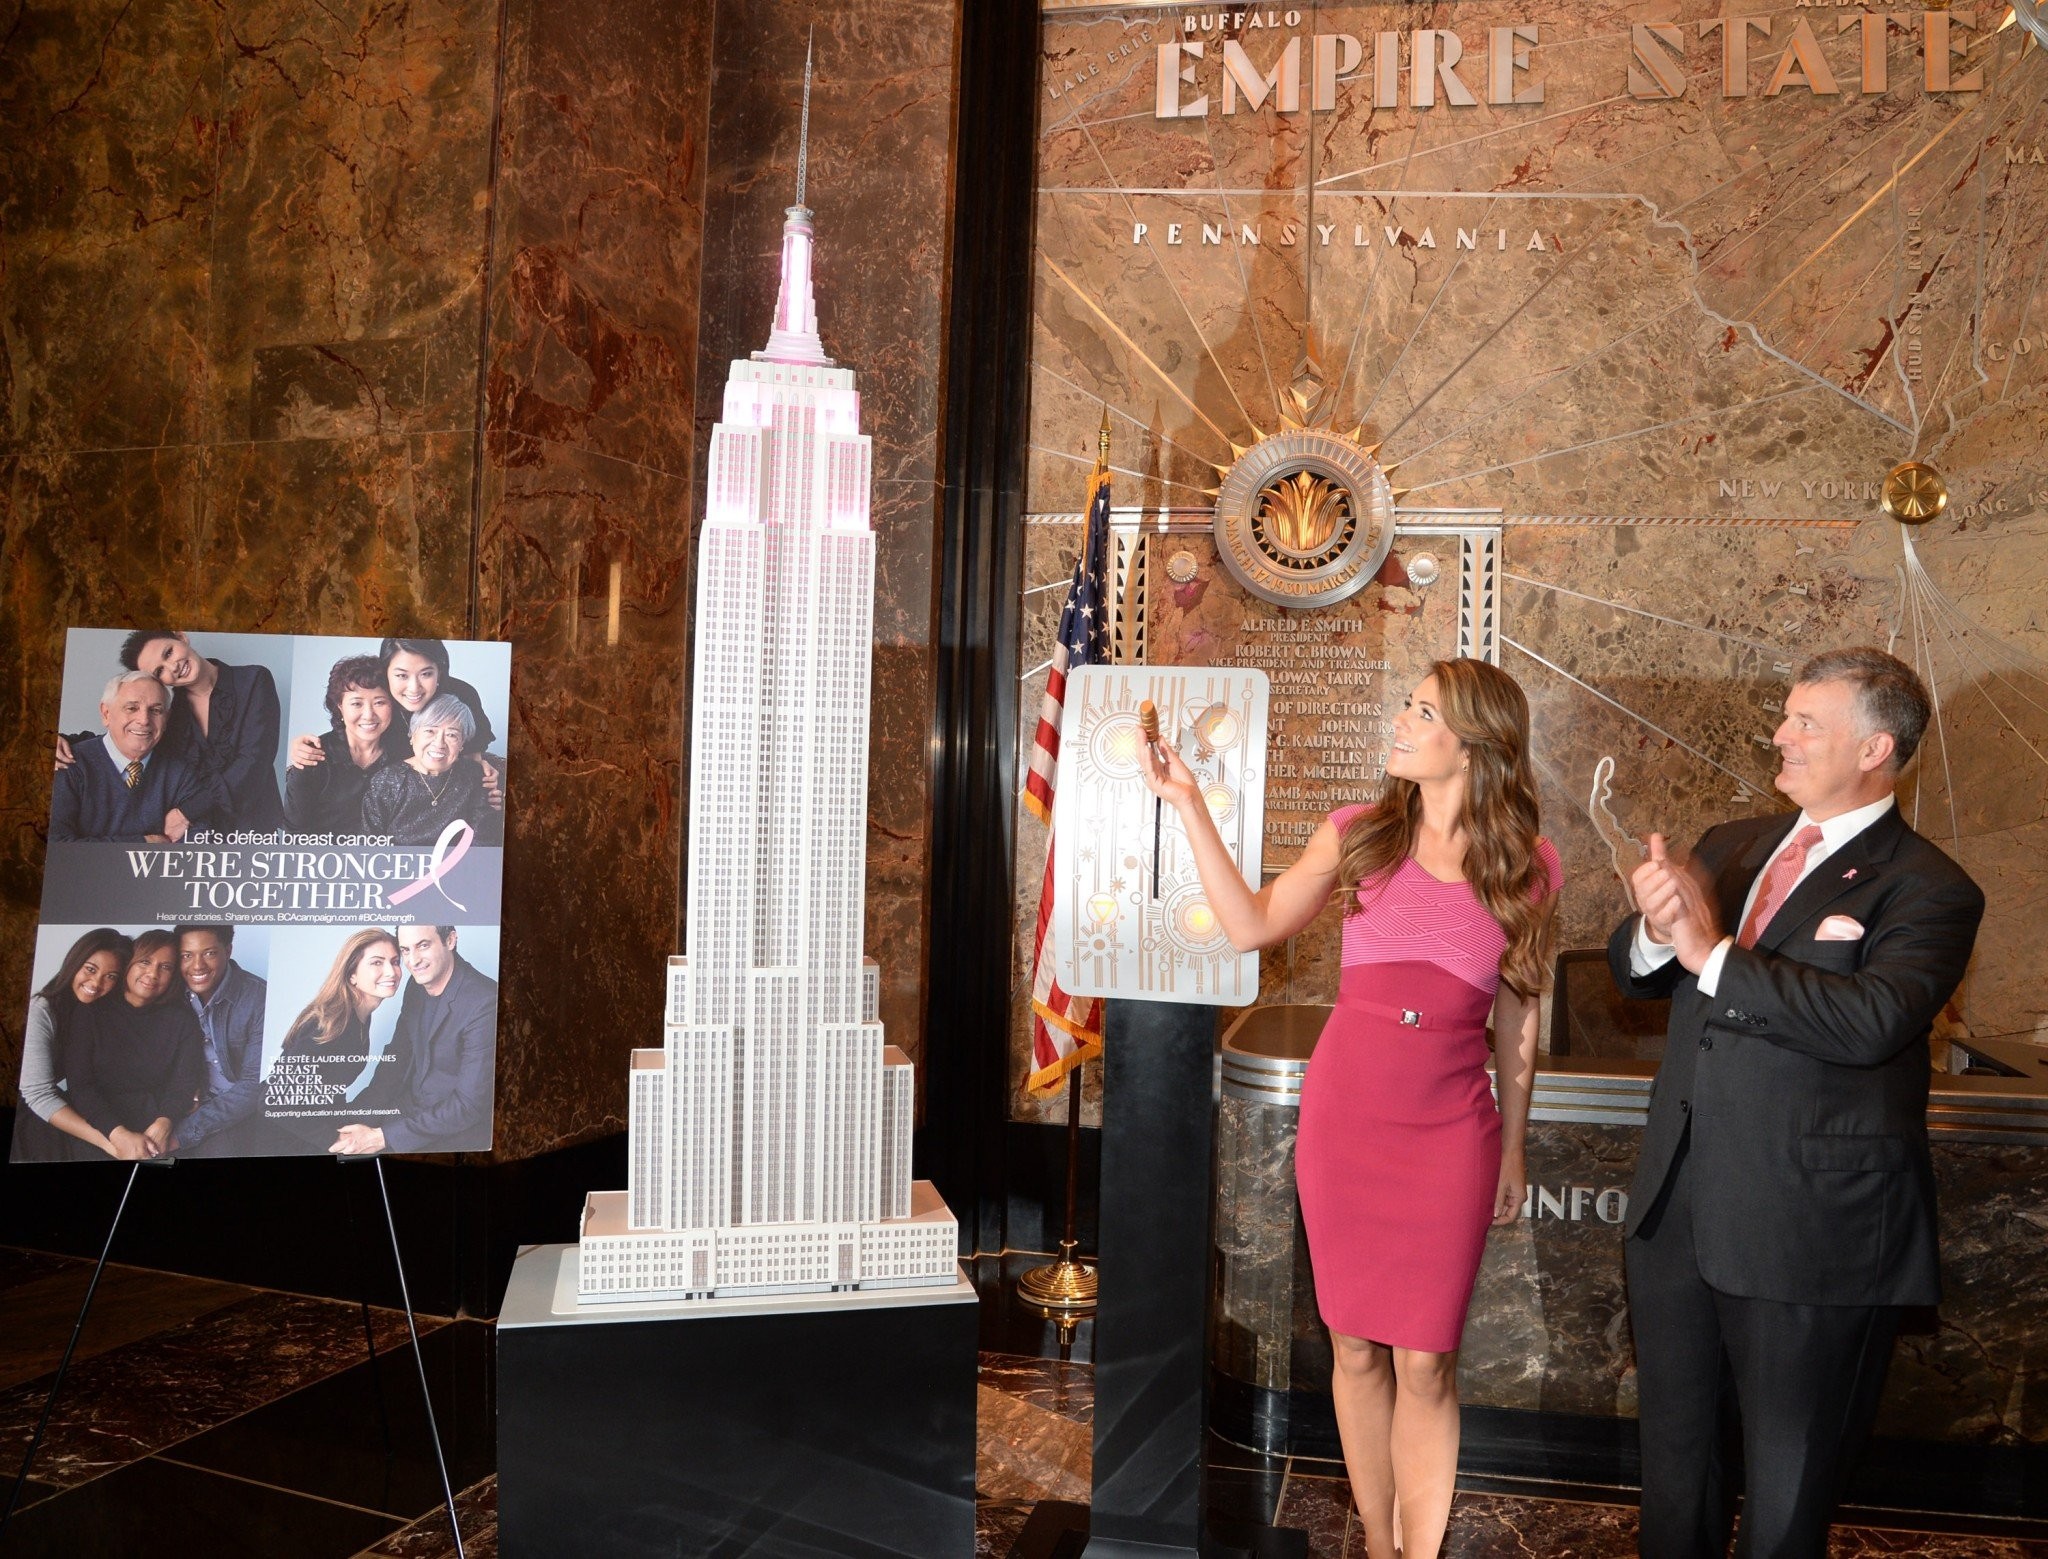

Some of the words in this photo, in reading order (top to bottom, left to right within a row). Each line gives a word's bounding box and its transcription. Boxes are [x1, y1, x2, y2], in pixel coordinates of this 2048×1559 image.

[1185, 9, 1302, 33] BUFFALO
[1048, 63, 1100, 100] LAKE
[1107, 30, 1152, 64] ERIE
[1155, 25, 1546, 119] EMPIRE
[1627, 10, 1984, 100] STATE
[1132, 222, 1547, 252] PENNSYLVANIA
[1908, 206, 1922, 270] RIVER
[1908, 292, 1923, 380] HUDSON
[1719, 479, 1784, 498] NEW
[1800, 480, 1881, 500] YORK
[1950, 499, 2008, 522] LONG
[1240, 618, 1297, 632] ALFRED
[1315, 619, 1363, 633] SMITH
[1270, 633, 1330, 643] PRESIDENT
[1235, 644, 1290, 658] ROBERT
[1310, 645, 1366, 659] BROWN
[1208, 657, 1234, 667] VICE
[1236, 657, 1295, 668] PRESIDENT
[1301, 659, 1324, 669] AND
[1329, 660, 1391, 670] TREASURER
[1325, 672, 1374, 685] TARRY
[1269, 685, 1330, 696] SECRETARY
[1273, 701, 1294, 715] OF
[1295, 702, 1382, 716] DIRECTORS
[1318, 720, 1360, 733] JOHN
[1292, 735, 1367, 749] KAUFMAN
[1321, 751, 1362, 764] ELLIS
[1266, 764, 1298, 778] HER
[1303, 765, 1369, 779] MICHAEL
[1265, 786, 1301, 799] AMB
[1304, 790, 1328, 801] AND
[1265, 801, 1331, 811] ARCHITECTS
[1265, 821, 1323, 835] OTHER
[184, 829, 223, 845] Let's
[227, 830, 278, 846] defeat
[282, 831, 334, 846] breast
[336, 834, 395, 847] cancer.
[1271, 835, 1311, 846] BUILDE
[126, 850, 242, 878] WE'RE
[251, 851, 434, 880] STRONGER
[184, 881, 392, 910] TOGETHER.
[156, 913, 178, 921] Hear
[194, 912, 222, 921] stories.
[225, 912, 249, 921] Share
[251, 914, 276, 923] yours.
[278, 913, 357, 923] BCAcampaign.com
[358, 913, 415, 923] #BCAstrength
[312, 1055, 345, 1064] LAUDER
[347, 1055, 397, 1063] COMPANIES
[268, 1064, 319, 1075] BREAST
[266, 1074, 323, 1085] CANCER
[265, 1084, 347, 1095] AWARENESS
[264, 1094, 334, 1106] CAMPAIGN
[264, 1110, 300, 1118] Supporting
[301, 1109, 333, 1117] education
